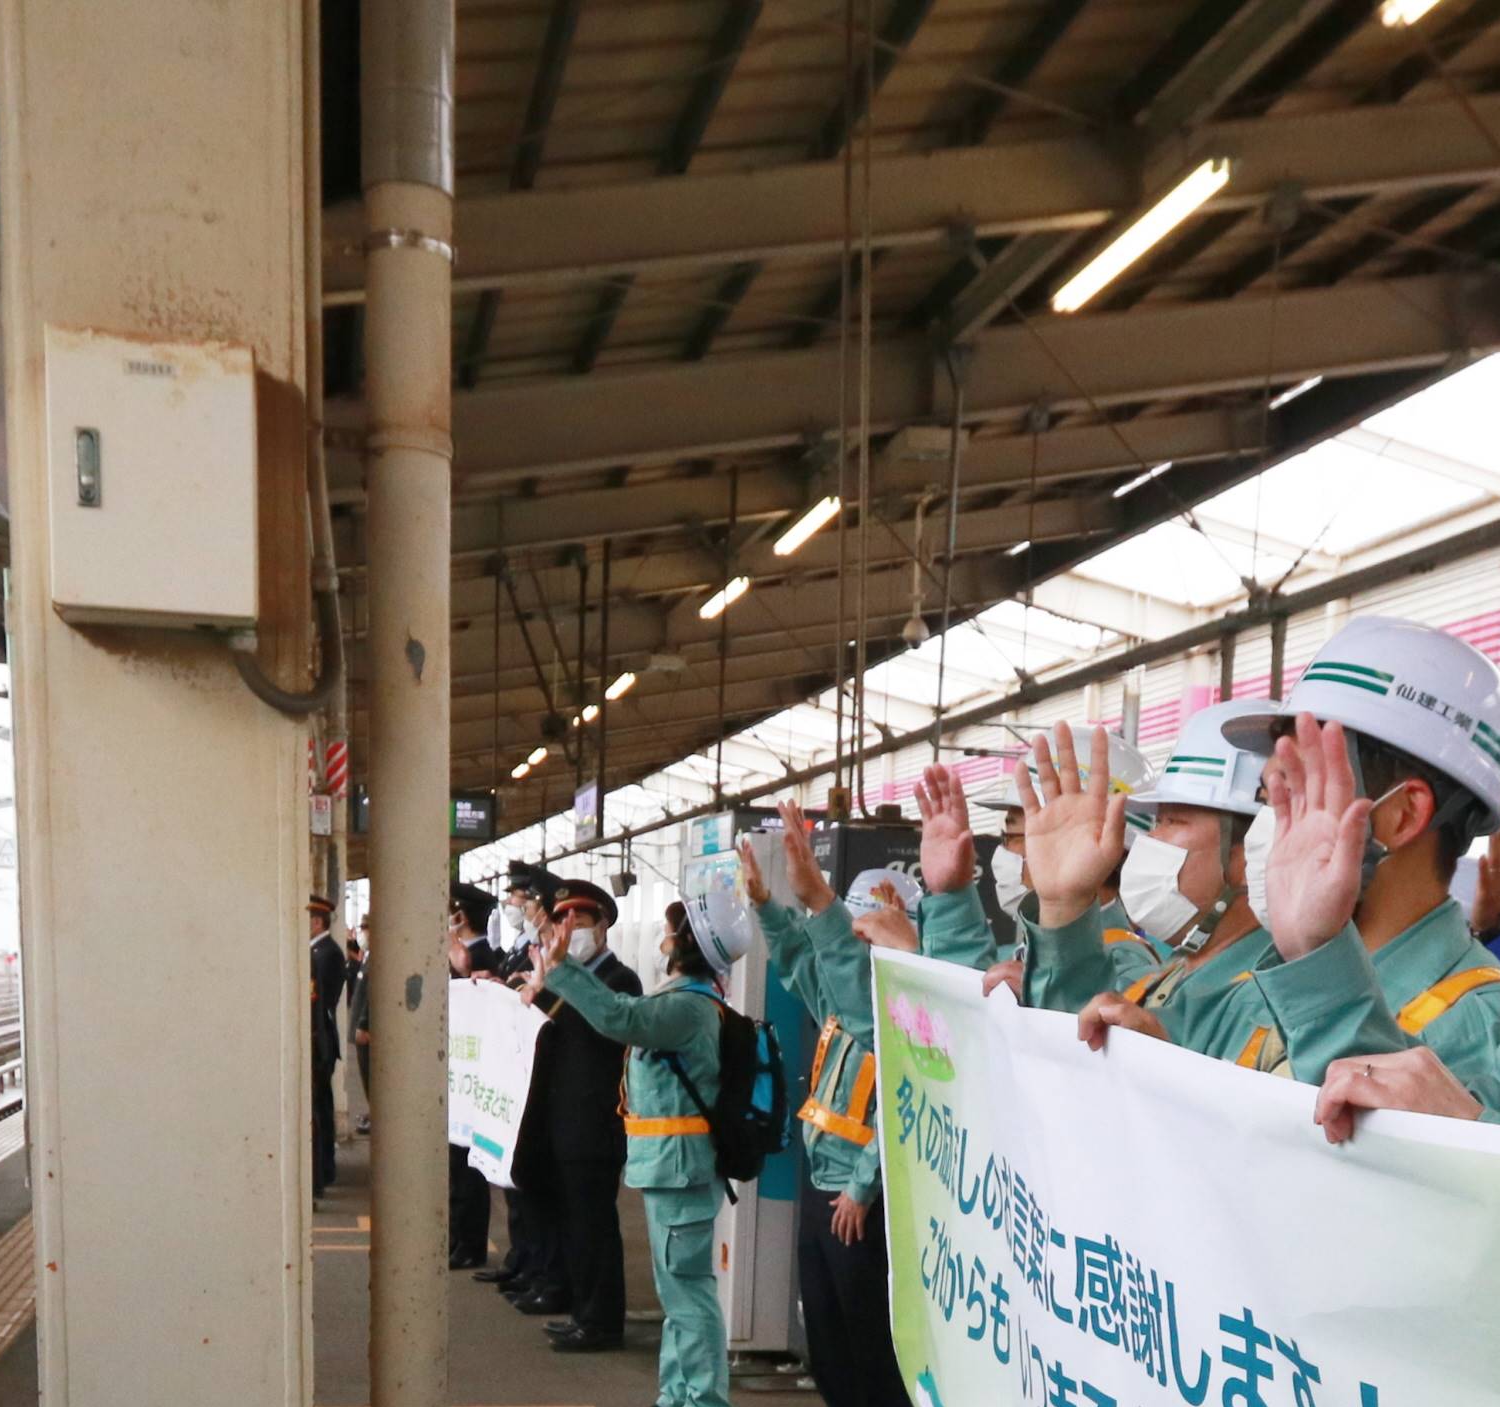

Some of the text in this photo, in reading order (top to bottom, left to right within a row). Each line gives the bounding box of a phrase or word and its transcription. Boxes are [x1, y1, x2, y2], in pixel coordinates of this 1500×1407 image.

[1395, 682, 1472, 734] 仙建工業
[920, 1215, 1012, 1366] これからも
